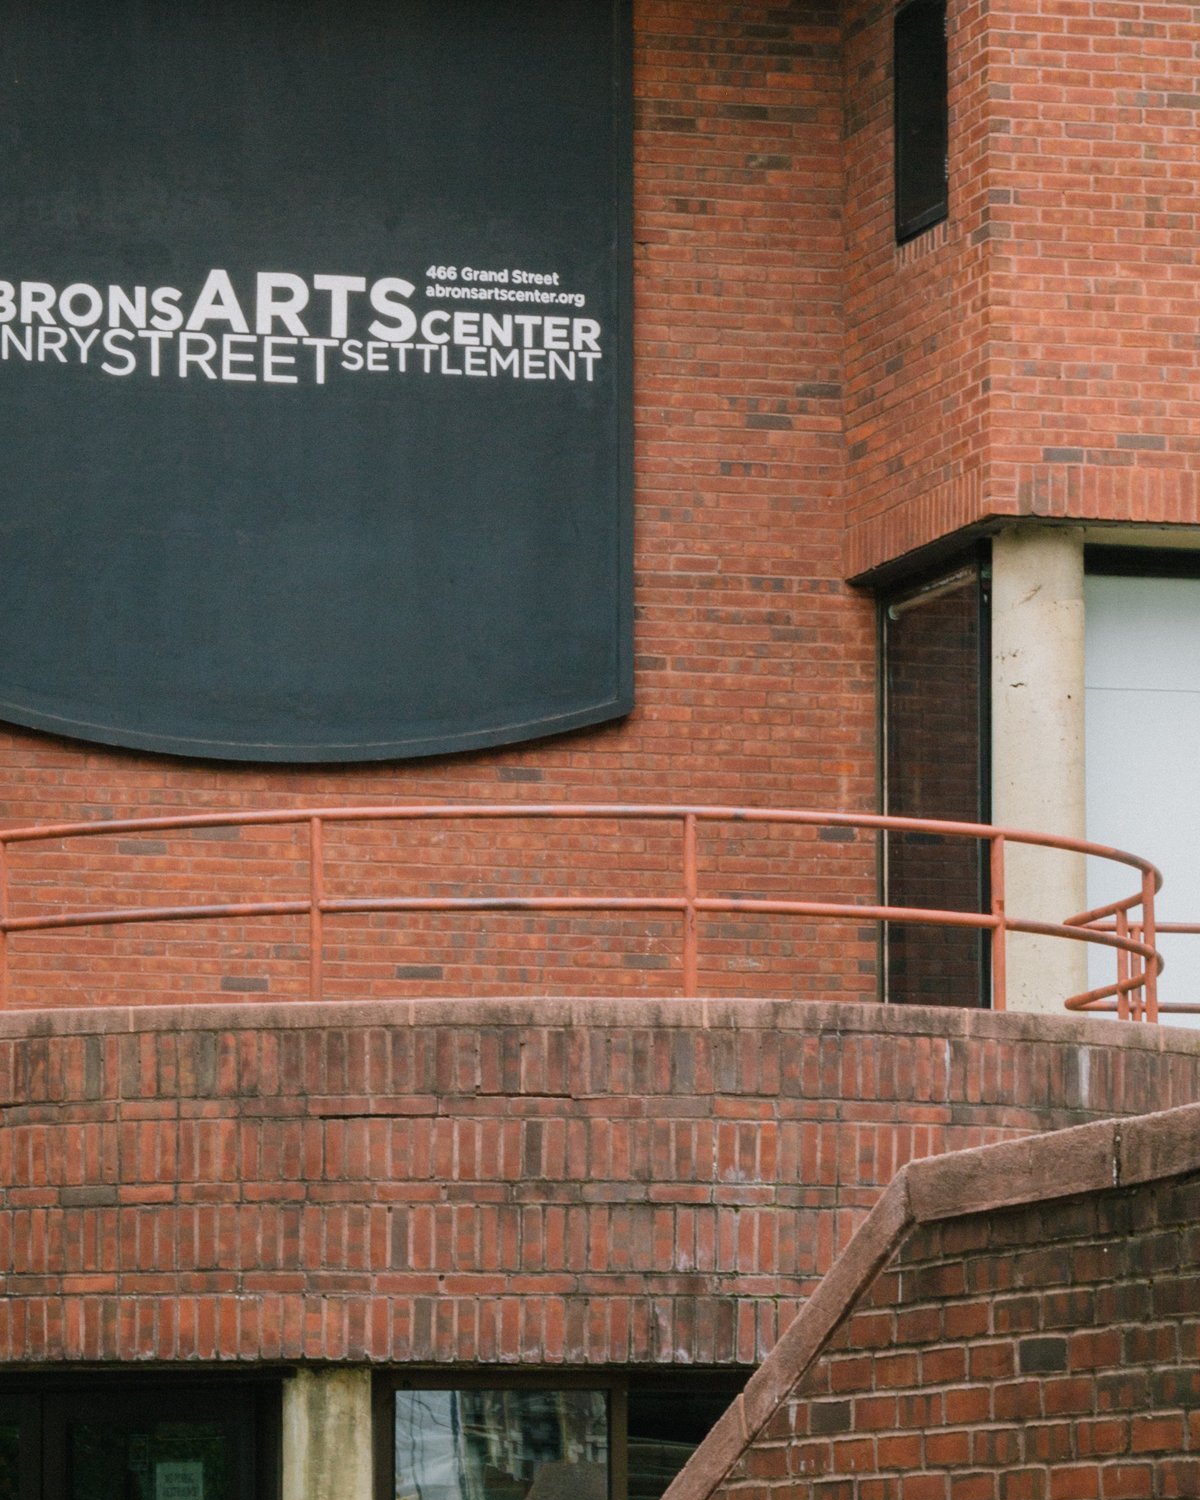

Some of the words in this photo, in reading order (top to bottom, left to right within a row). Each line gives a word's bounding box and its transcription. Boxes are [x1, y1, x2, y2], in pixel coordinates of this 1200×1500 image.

[425, 264, 458, 282] 466
[460, 266, 509, 285] Grand
[511, 269, 560, 287] Street
[425, 282, 586, 308] abronsartscenter.org
[184, 269, 418, 343] ARTS
[419, 309, 602, 352] CENTER
[101, 328, 341, 385] STREET
[341, 338, 603, 382] SETTLEMENT
